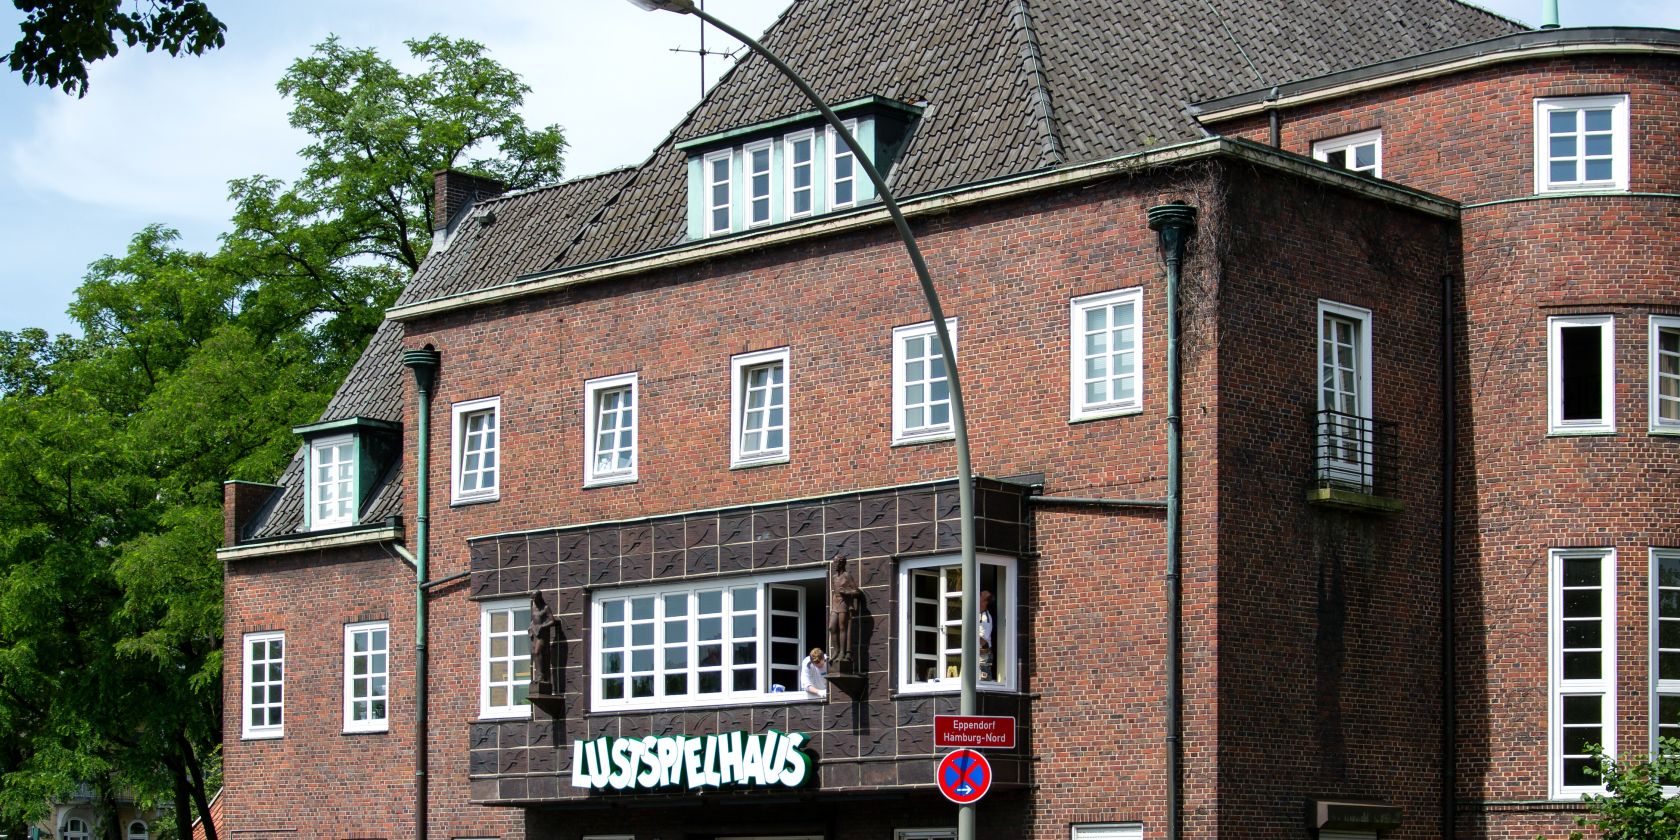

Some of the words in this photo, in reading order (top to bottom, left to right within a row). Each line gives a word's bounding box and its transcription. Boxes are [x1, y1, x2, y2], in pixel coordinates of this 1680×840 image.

[953, 720, 996, 731] Eppendorf
[943, 732, 1006, 744] Hamburg-Nord
[572, 730, 806, 789] LUSTSPIELHAUS
